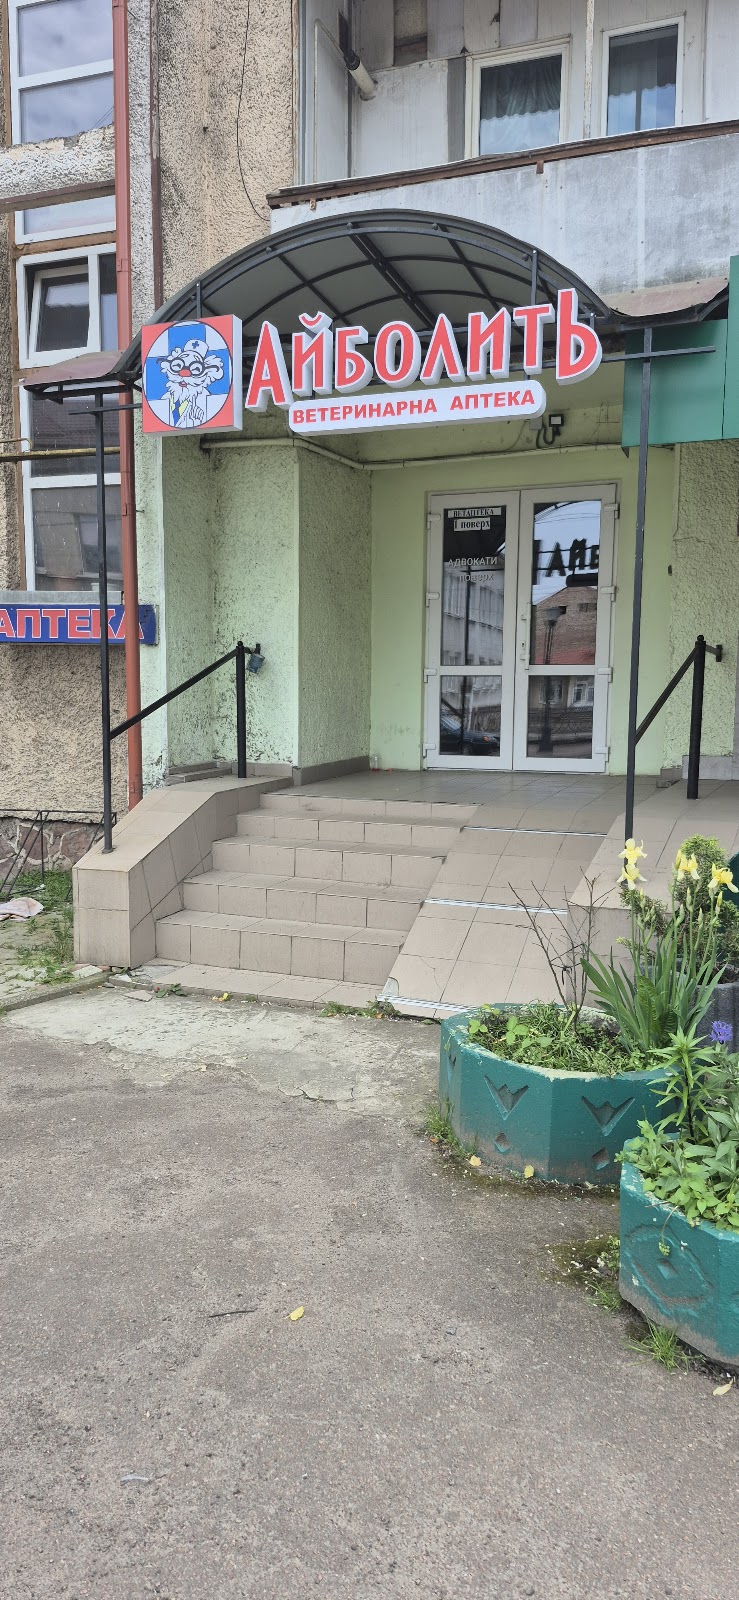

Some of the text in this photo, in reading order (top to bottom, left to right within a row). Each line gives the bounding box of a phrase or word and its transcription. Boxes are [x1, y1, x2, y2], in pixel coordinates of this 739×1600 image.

[245, 288, 602, 410] АЙБОЛИТЬ
[293, 389, 535, 424] ВЕТЕРИНАРНА АПТЕКА
[460, 520, 490, 531] поверх
[448, 556, 498, 568] АДВОКАТИ
